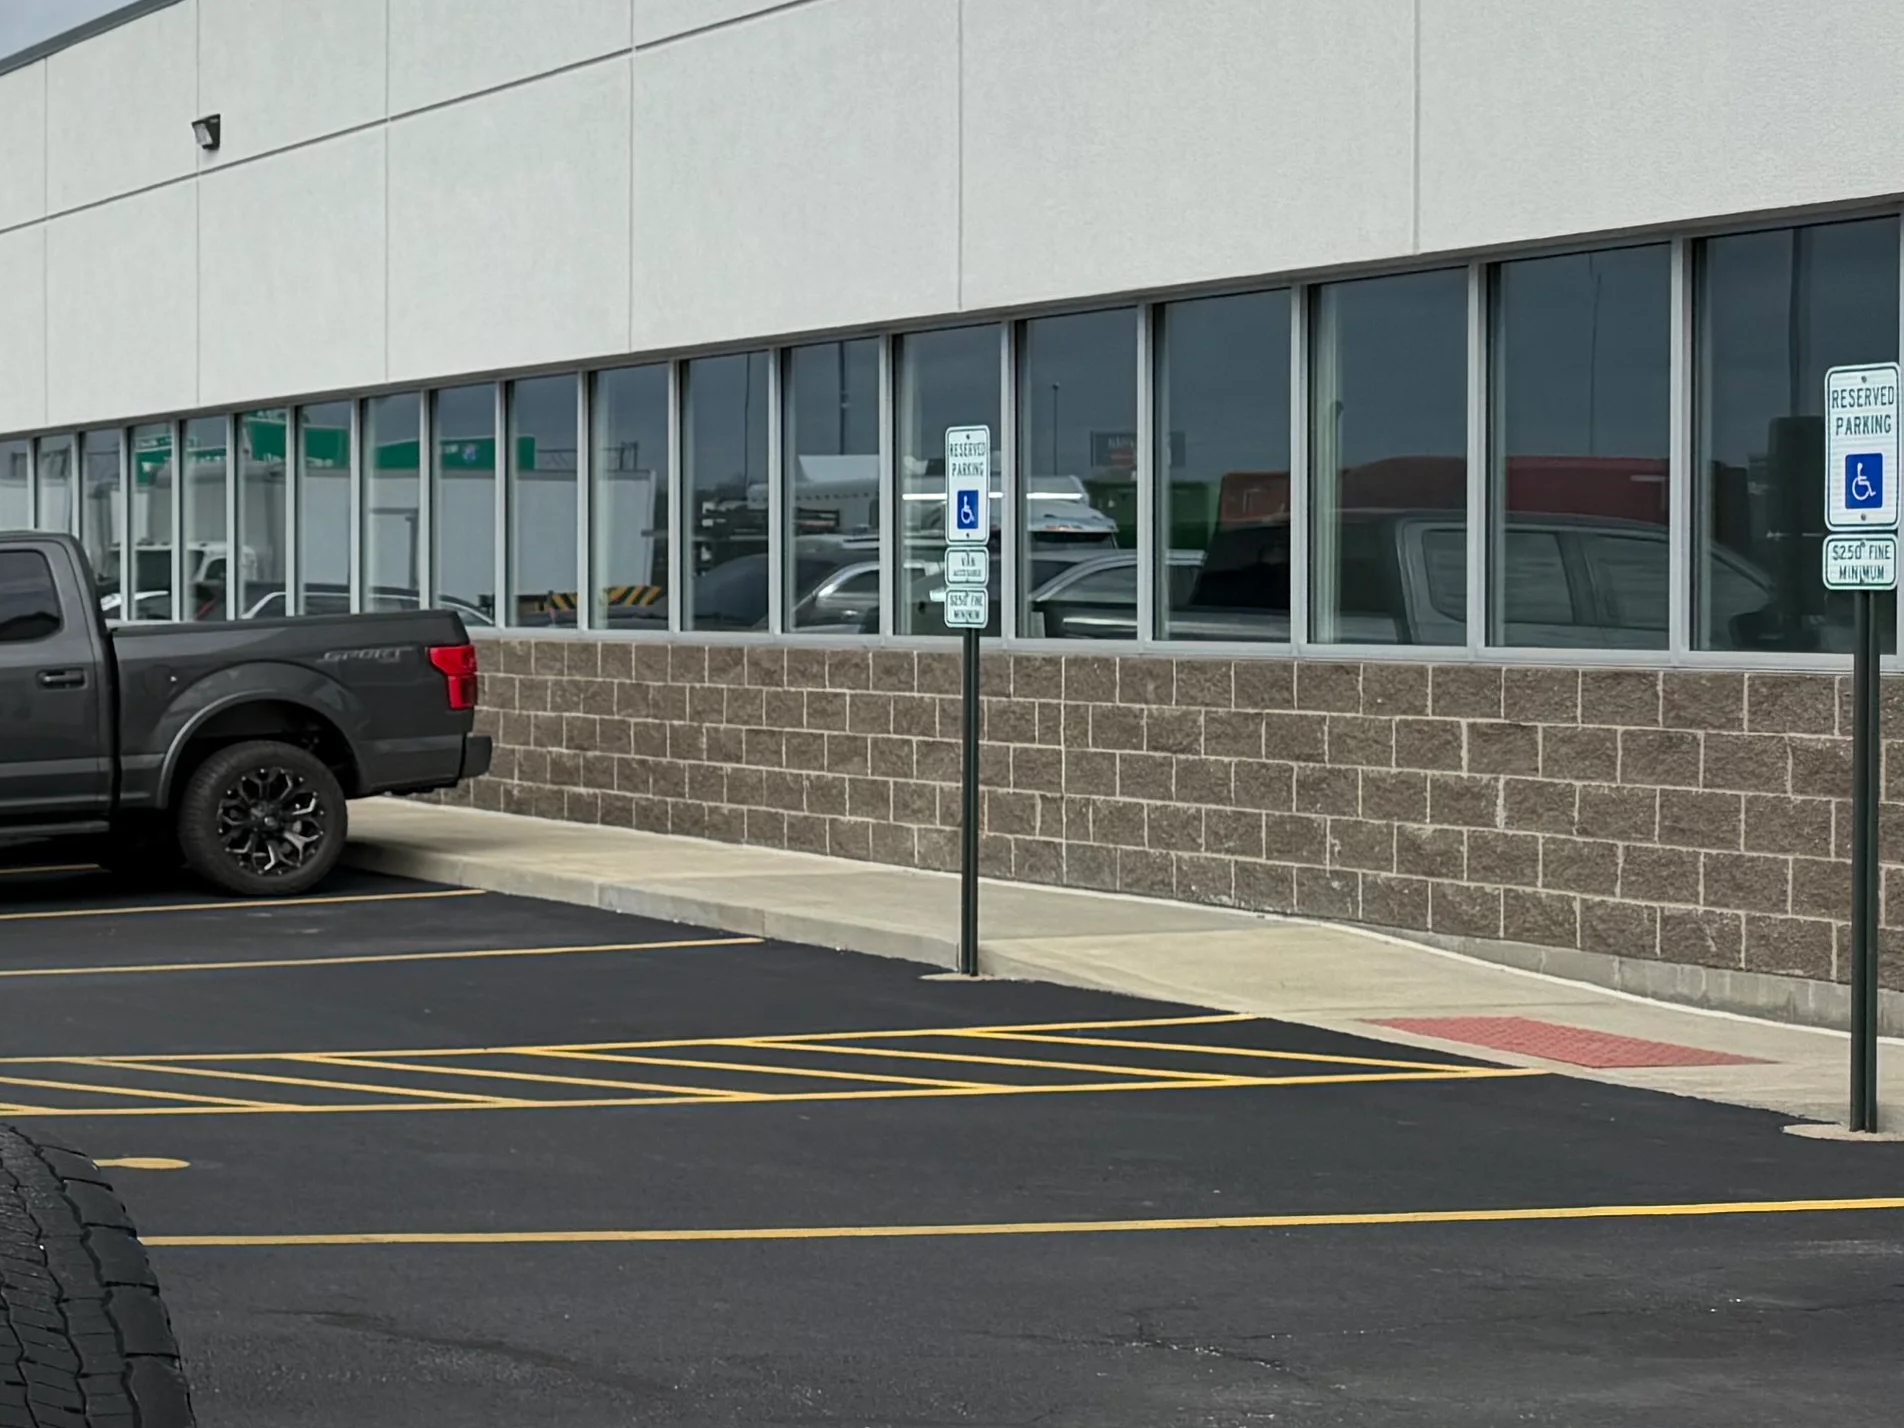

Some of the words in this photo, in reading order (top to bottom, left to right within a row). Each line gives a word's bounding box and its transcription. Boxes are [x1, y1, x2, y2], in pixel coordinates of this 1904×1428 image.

[1832, 385, 1895, 409] RESERVED
[1836, 414, 1892, 437] PARKING
[950, 442, 986, 458] RESERVED
[952, 462, 984, 478] PARKING
[1832, 544, 1862, 561] $250
[1869, 544, 1891, 560] FINE
[1839, 565, 1885, 581] MINIMUM
[315, 646, 414, 663] SPORT
